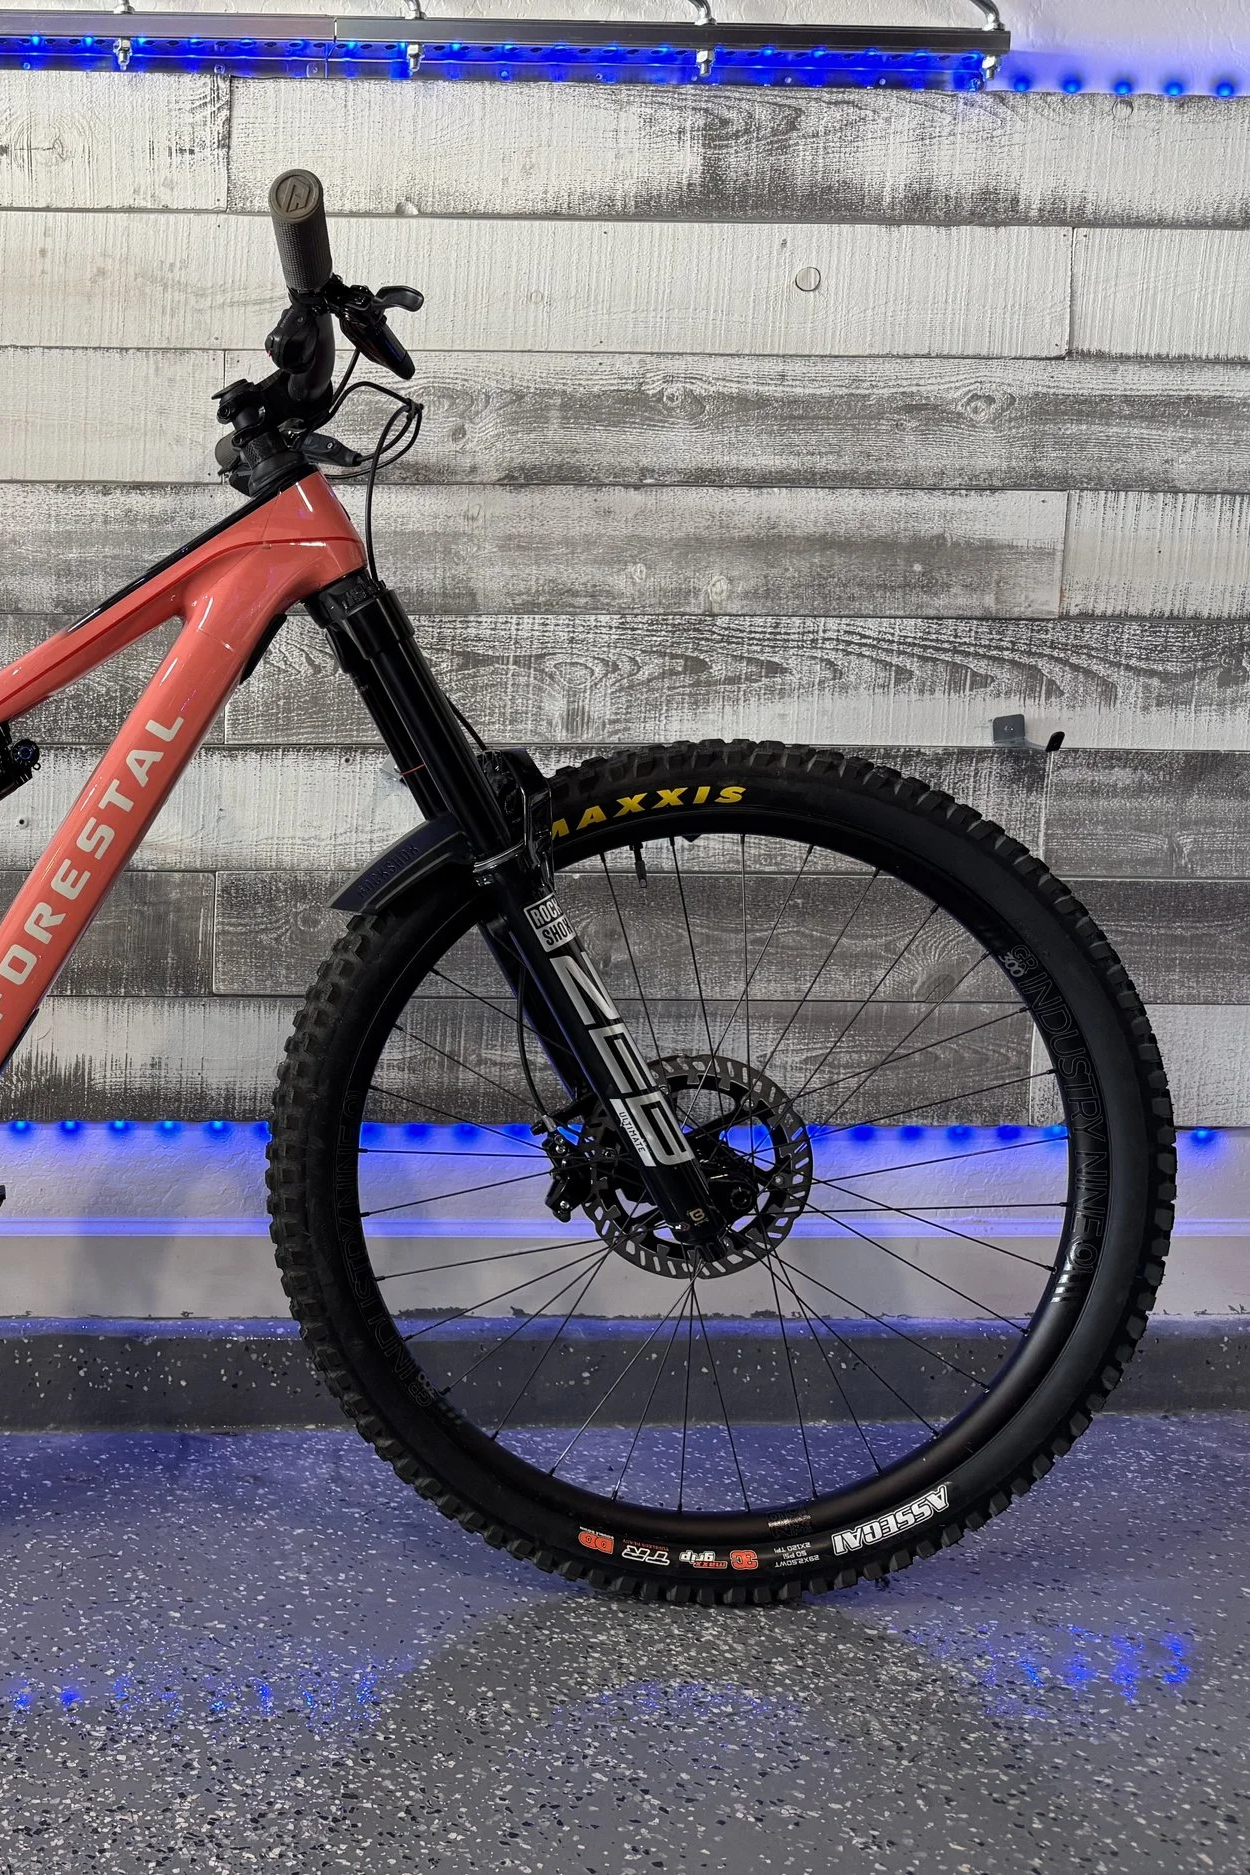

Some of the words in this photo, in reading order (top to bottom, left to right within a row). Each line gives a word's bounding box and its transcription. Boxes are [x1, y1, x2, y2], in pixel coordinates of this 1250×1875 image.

[530, 895, 564, 930] ROCK
[541, 919, 574, 947] SHOX
[1017, 972, 1106, 1143] INDUSTRY
[1071, 1150, 1108, 1240] NINE
[618, 1111, 647, 1155] ULTIMATE
[832, 1484, 950, 1556] ASSEGAI
[577, 1530, 615, 1555] DD
[621, 1544, 671, 1566] TR
[678, 1549, 716, 1564] grip
[693, 1559, 728, 1569] maxx
